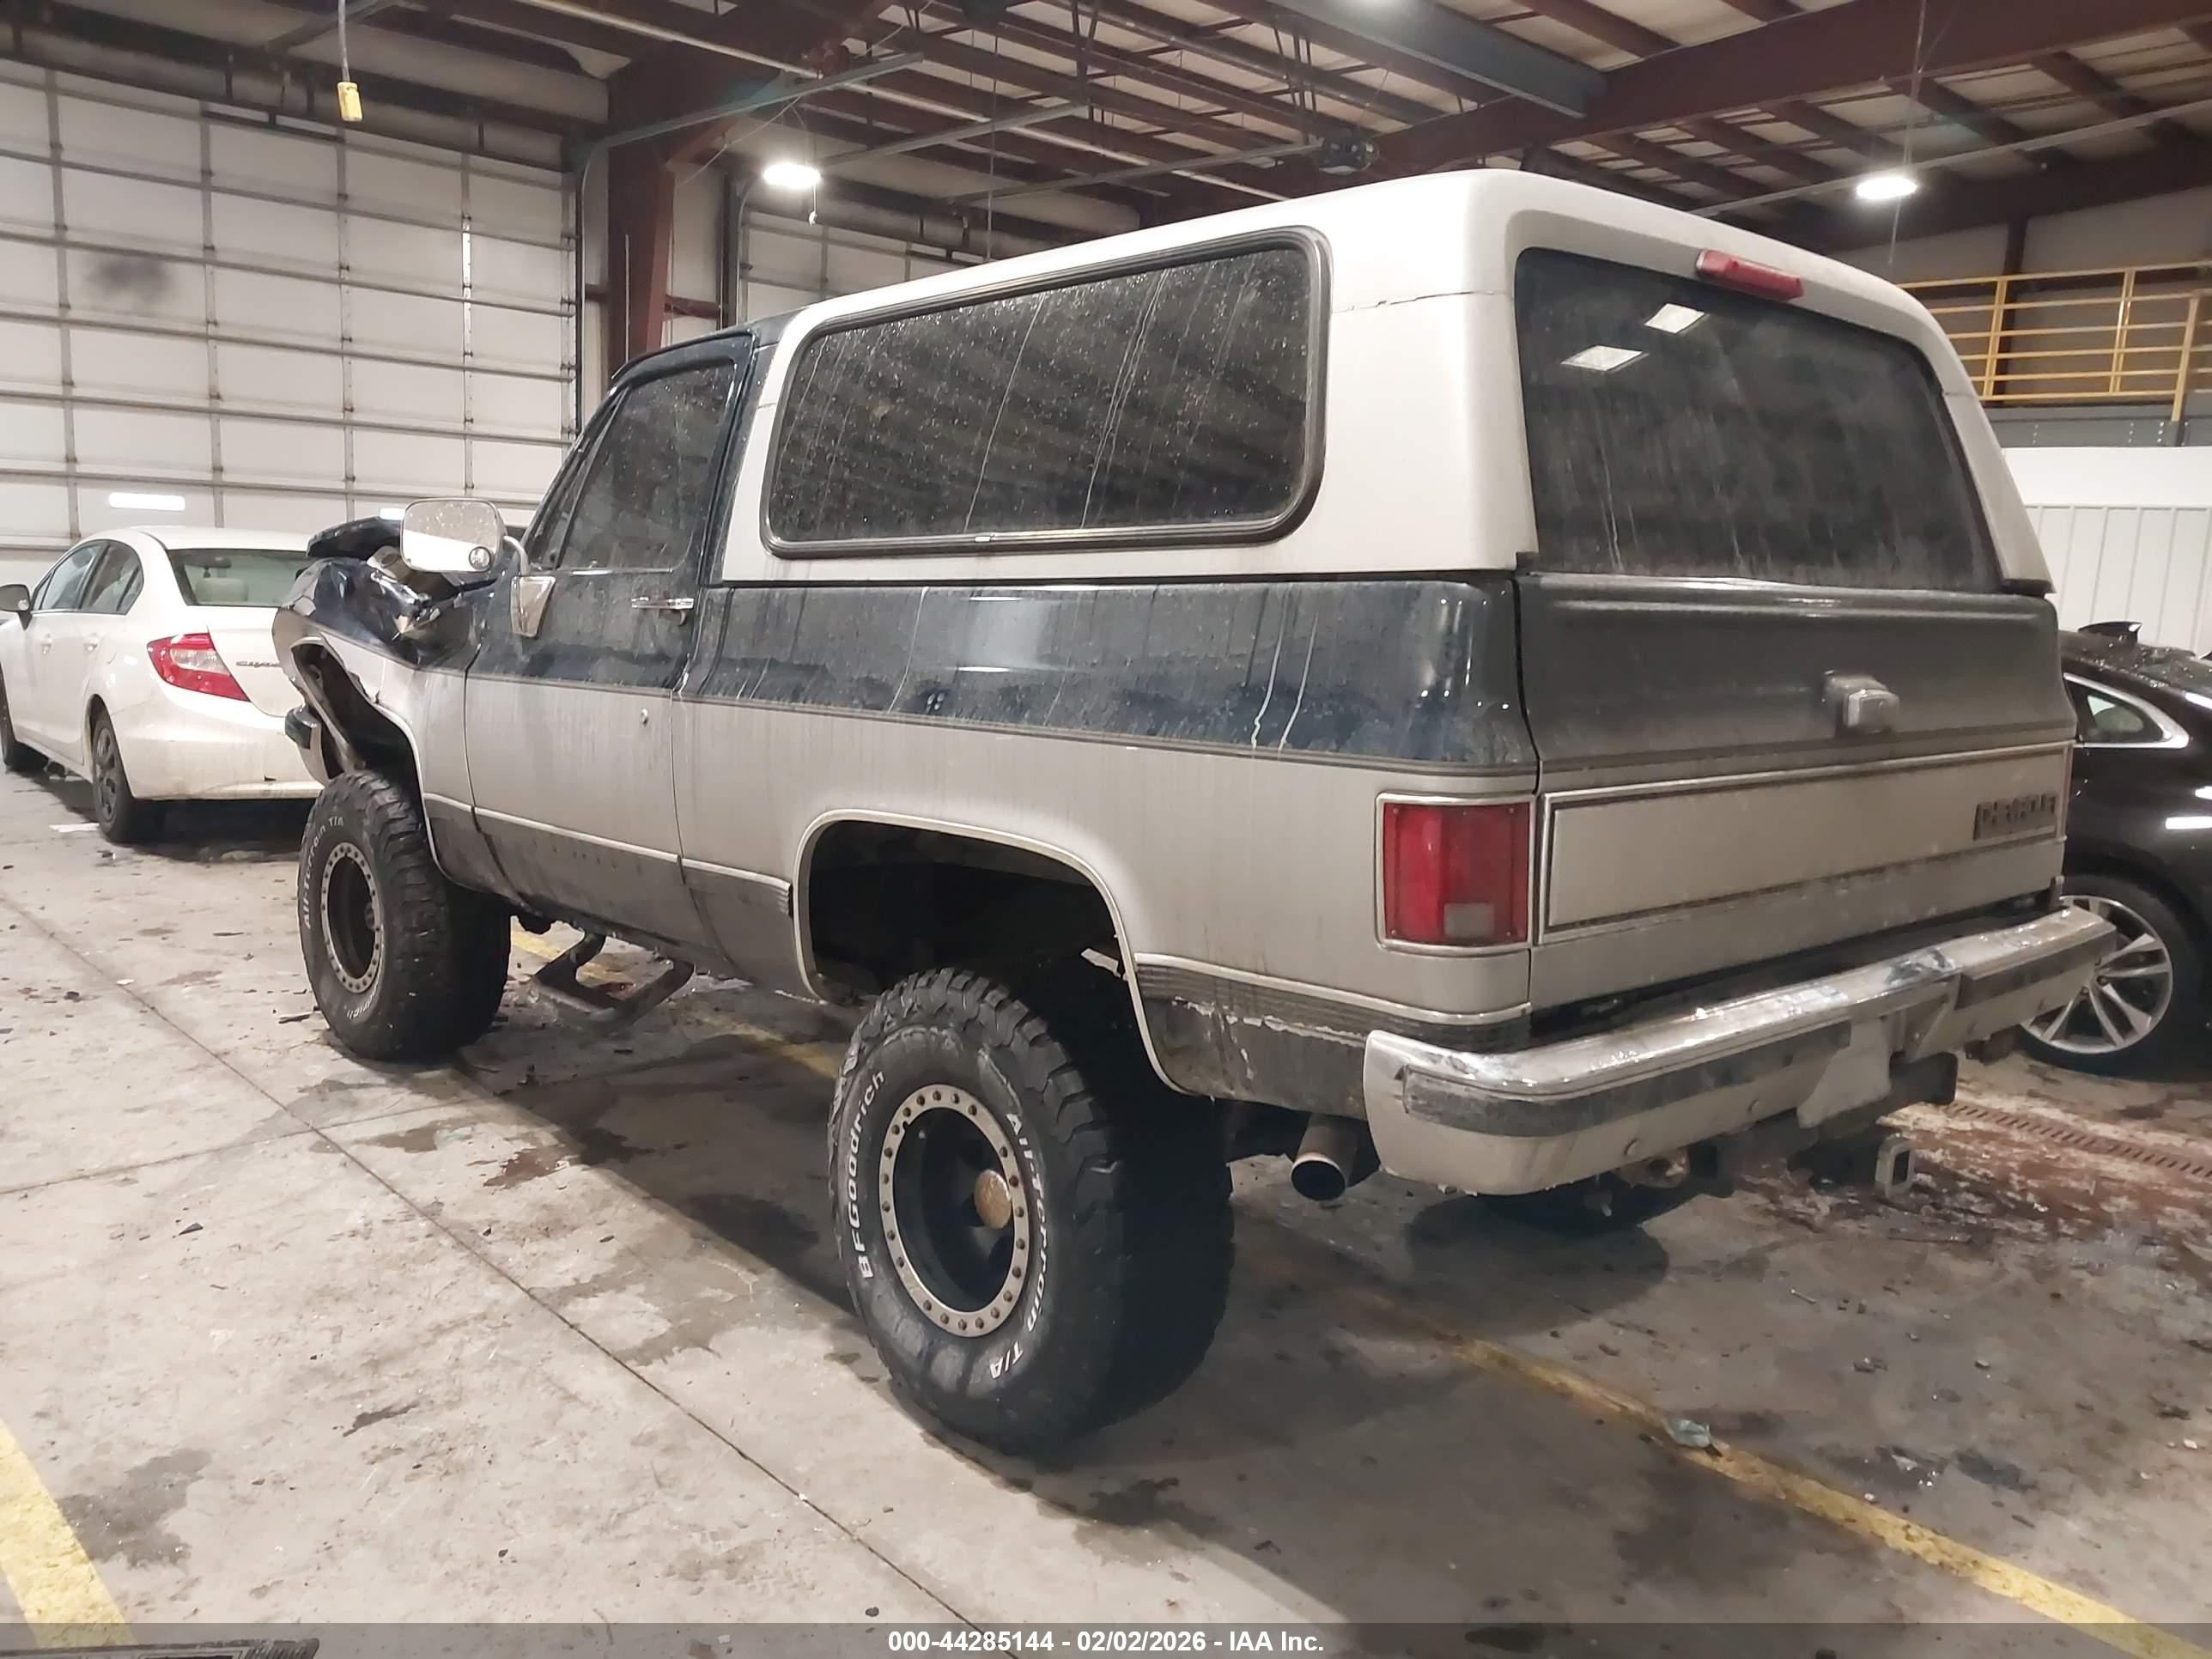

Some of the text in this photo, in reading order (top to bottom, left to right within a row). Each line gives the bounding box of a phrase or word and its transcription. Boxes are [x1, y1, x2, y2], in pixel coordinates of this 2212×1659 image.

[848, 1070, 885, 1278] BFGoodrich
[989, 1113, 1048, 1379] All-Terrain T/A
